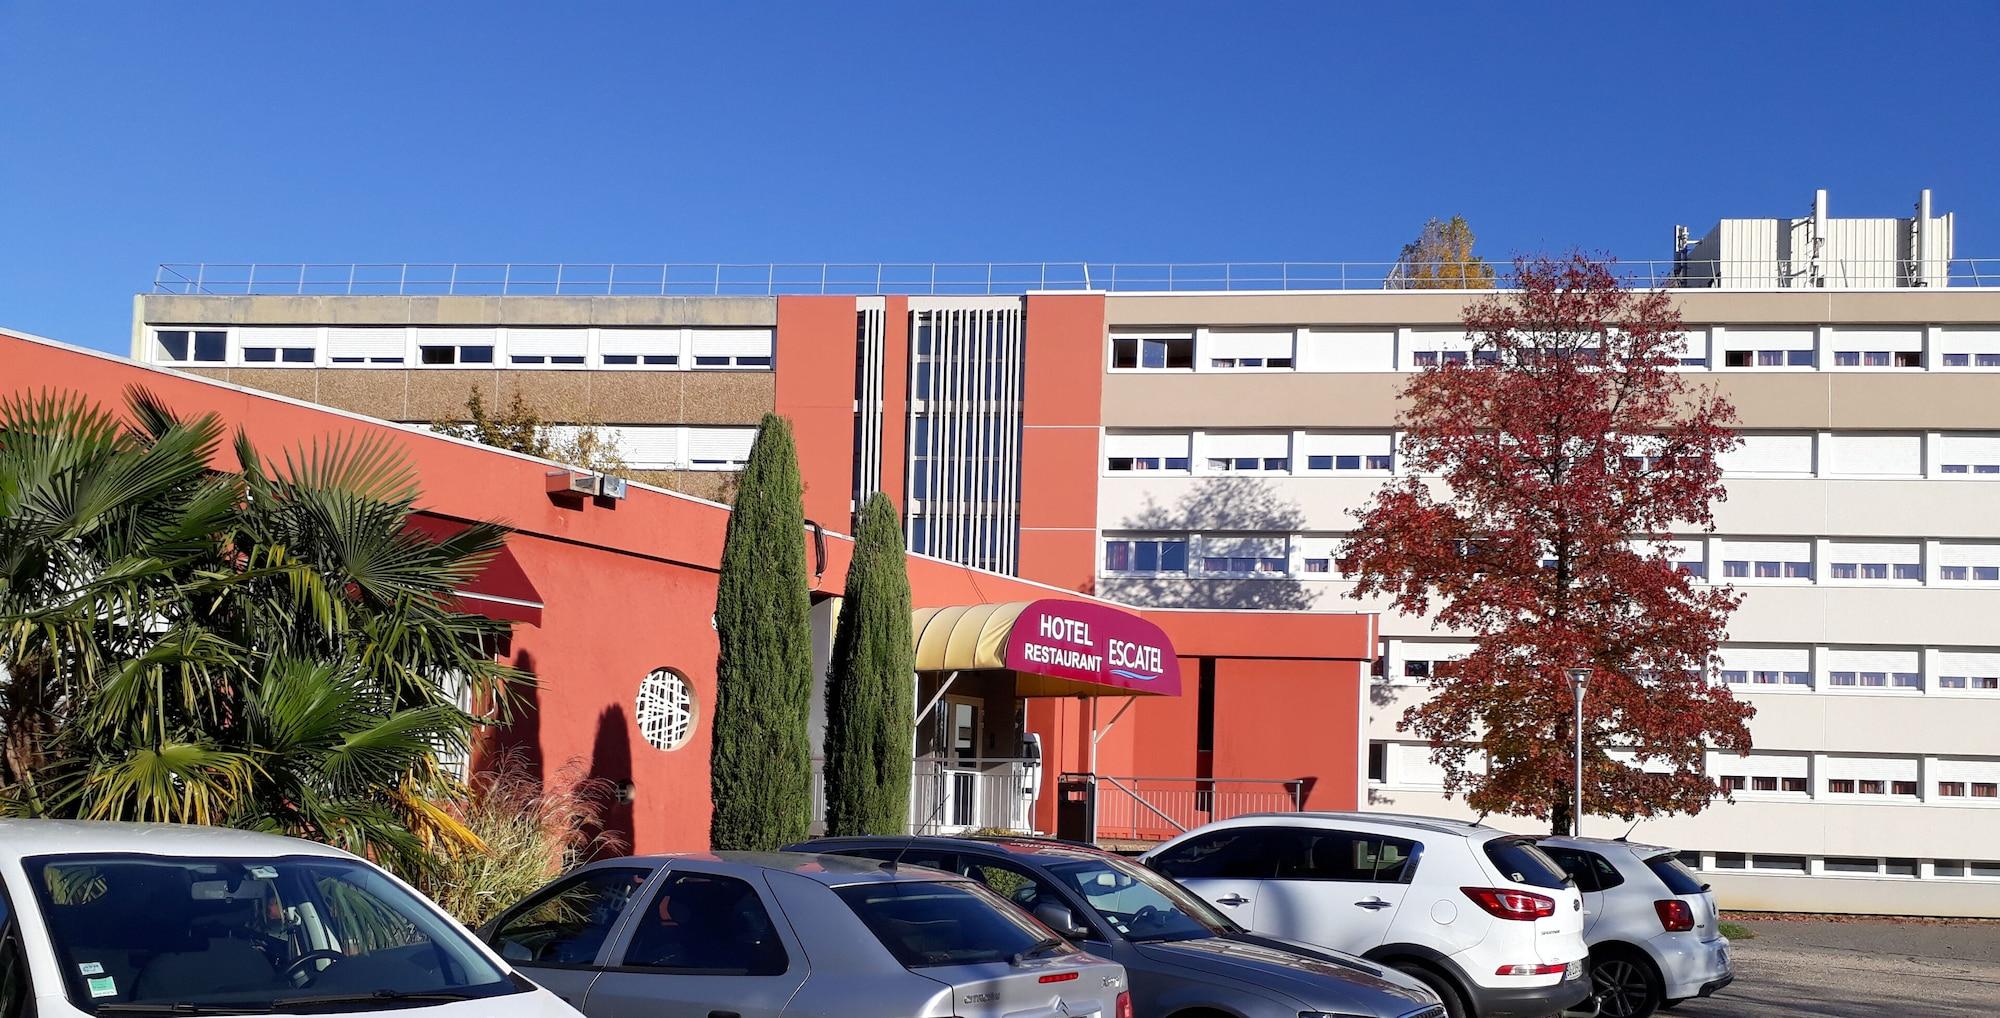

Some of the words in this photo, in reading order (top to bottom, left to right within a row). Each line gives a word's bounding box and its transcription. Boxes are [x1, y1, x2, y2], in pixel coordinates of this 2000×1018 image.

[1040, 613, 1094, 646] HOTEL
[1024, 642, 1102, 672] RESTAURANT
[1108, 638, 1164, 674] ESCATEL
